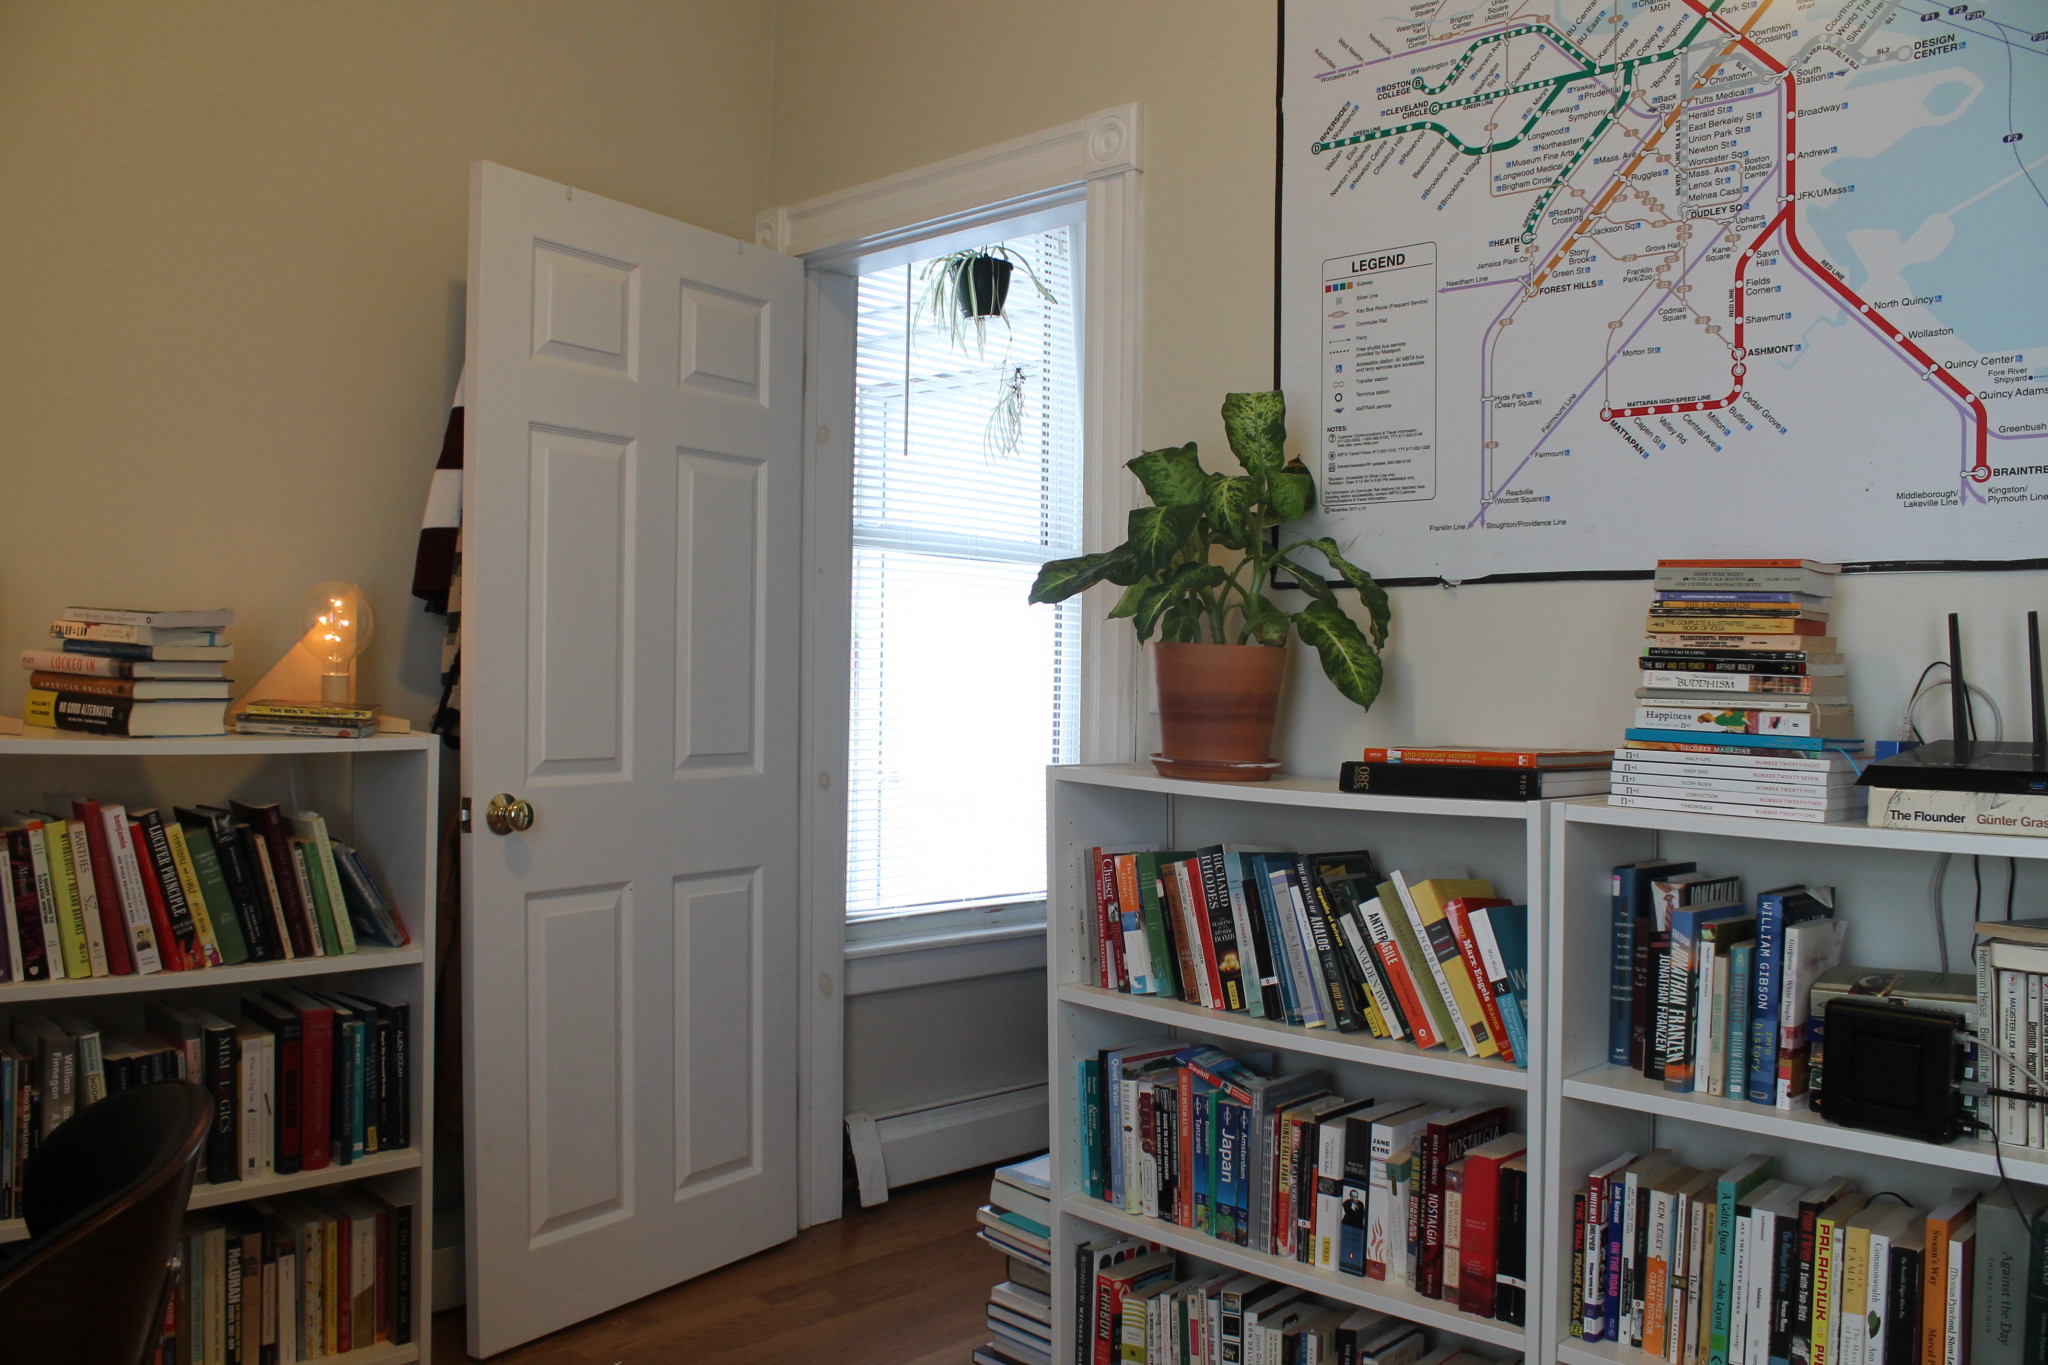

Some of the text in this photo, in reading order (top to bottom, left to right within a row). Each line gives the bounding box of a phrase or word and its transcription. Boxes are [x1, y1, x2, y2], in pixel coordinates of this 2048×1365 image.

[1720, 6, 1739, 15] Park
[1657, 19, 1685, 52] Arlington
[1749, 23, 1791, 38] Downtown
[1755, 31, 1791, 45] Crossing
[1598, 27, 1624, 59] Kenmore
[1618, 38, 1639, 61] Hynes
[1636, 31, 1659, 57] Copley
[1913, 43, 1958, 60] CENTER
[1914, 34, 1955, 50] DESIGN
[1710, 71, 1752, 85] Chinatown
[1797, 65, 1821, 77] South
[1797, 73, 1826, 86] Station
[1377, 87, 1411, 100] COLLEGE
[1381, 79, 1411, 92] BOSTON
[1584, 85, 1621, 100] Prudential
[1695, 88, 1748, 106] Tufts Medical
[1386, 101, 1429, 116] CLEVELAND
[1402, 108, 1428, 120] CIRCLE
[1546, 106, 1574, 116] Fenway
[1568, 109, 1607, 122] Symphony
[1797, 103, 1841, 117] Broadway
[1320, 106, 1349, 142] RIVERSIDE
[1527, 128, 1565, 141] Longwood
[1538, 136, 1585, 151] Northeastern
[2007, 134, 2019, 142] F2
[1402, 130, 1426, 162] Reservoir
[1797, 149, 1831, 160] Andrew
[1413, 138, 1445, 179] Beaconsfield
[1512, 150, 1574, 168] Museum Fine Arts
[1425, 151, 1460, 196] Brookline Hills
[1440, 155, 1482, 206] Brookline Village
[1796, 186, 1848, 201] JFK/UMass
[1691, 204, 1743, 218] DUDLEY SQ
[1494, 236, 1520, 247] HEATH
[1352, 253, 1406, 273] LEGEND
[1552, 267, 1585, 278] Green St
[1539, 280, 1597, 295] FOREST HILLS
[1874, 295, 1934, 309] North Quincy
[1745, 313, 1785, 324] Shawmut
[1908, 328, 1954, 339] Wollaston
[1748, 345, 1794, 356] ASHMONT
[1945, 355, 2014, 370] Quincy Center
[1978, 390, 2013, 400] Quincy
[1728, 406, 1748, 426] Butler
[1742, 392, 1782, 429] Cedar Grove
[1706, 411, 1726, 432] Milton
[1609, 420, 1645, 455] MATTAPAN
[51, 658, 96, 672] LOCKED IN
[1676, 677, 1735, 689] BUDDHISM
[59, 701, 114, 718] NO GOOD ALTERNATIVE
[1646, 711, 1692, 721] Happiness
[1680, 744, 1751, 755] DECODER MAGAZINE
[1357, 766, 1370, 789] 380
[1519, 774, 1527, 795] 2016
[1890, 809, 1966, 823] The Flounder
[1977, 814, 2018, 826] Günter
[113, 815, 127, 849] benjamin
[75, 831, 89, 873] BARTHES
[148, 826, 187, 917] LUCIFER PRINCIPLE
[1102, 858, 1113, 899] Chaser
[1213, 853, 1229, 907] RICHARD
[1201, 855, 1220, 910] RHODES
[1301, 876, 1313, 903] REVENGE
[1310, 905, 1317, 914] OF
[1316, 887, 1344, 947] Republic of Drivers
[1310, 916, 1331, 951] ANALOG
[1368, 912, 1399, 966] ANTIFRAGILE
[1758, 901, 1772, 1010] WILLIAM GIBSON
[1358, 945, 1390, 1011] WALDEN TWO
[1414, 923, 1462, 1023] TANGIBLE THINGS
[1458, 925, 1466, 938] THE
[1486, 1003, 1500, 1030] READER
[1979, 950, 1988, 1017] Hermann Hesse
[1330, 982, 1345, 1011] DAVID SAX
[1666, 942, 1688, 1063] JONATHAN FRANZEN
[1753, 1023, 1764, 1072] history
[49, 1052, 61, 1099] Finnegan
[64, 1054, 73, 1094] William
[1188, 1063, 1209, 1080] Swahili
[1280, 1119, 1290, 1187] THINGS FALL APART
[1372, 1139, 1390, 1147] JANE
[1372, 1146, 1390, 1154] EYRE
[1218, 1128, 1235, 1183] Japan
[1240, 1132, 1248, 1179] Amsterdam
[1426, 1193, 1438, 1246] NOSTALGIA
[1655, 1200, 1666, 1251] KEN KESEY
[1928, 1230, 1941, 1287] Swann's Way
[228, 1248, 241, 1304] McLUHAN
[1609, 1241, 1620, 1297] ON THE ROAD
[1815, 1224, 1831, 1321] PALAHNIUK
[1871, 1243, 1882, 1303] Commonwealth
[1997, 1251, 2013, 1347] Against the Day
[1099, 1285, 1112, 1342] CHABON
